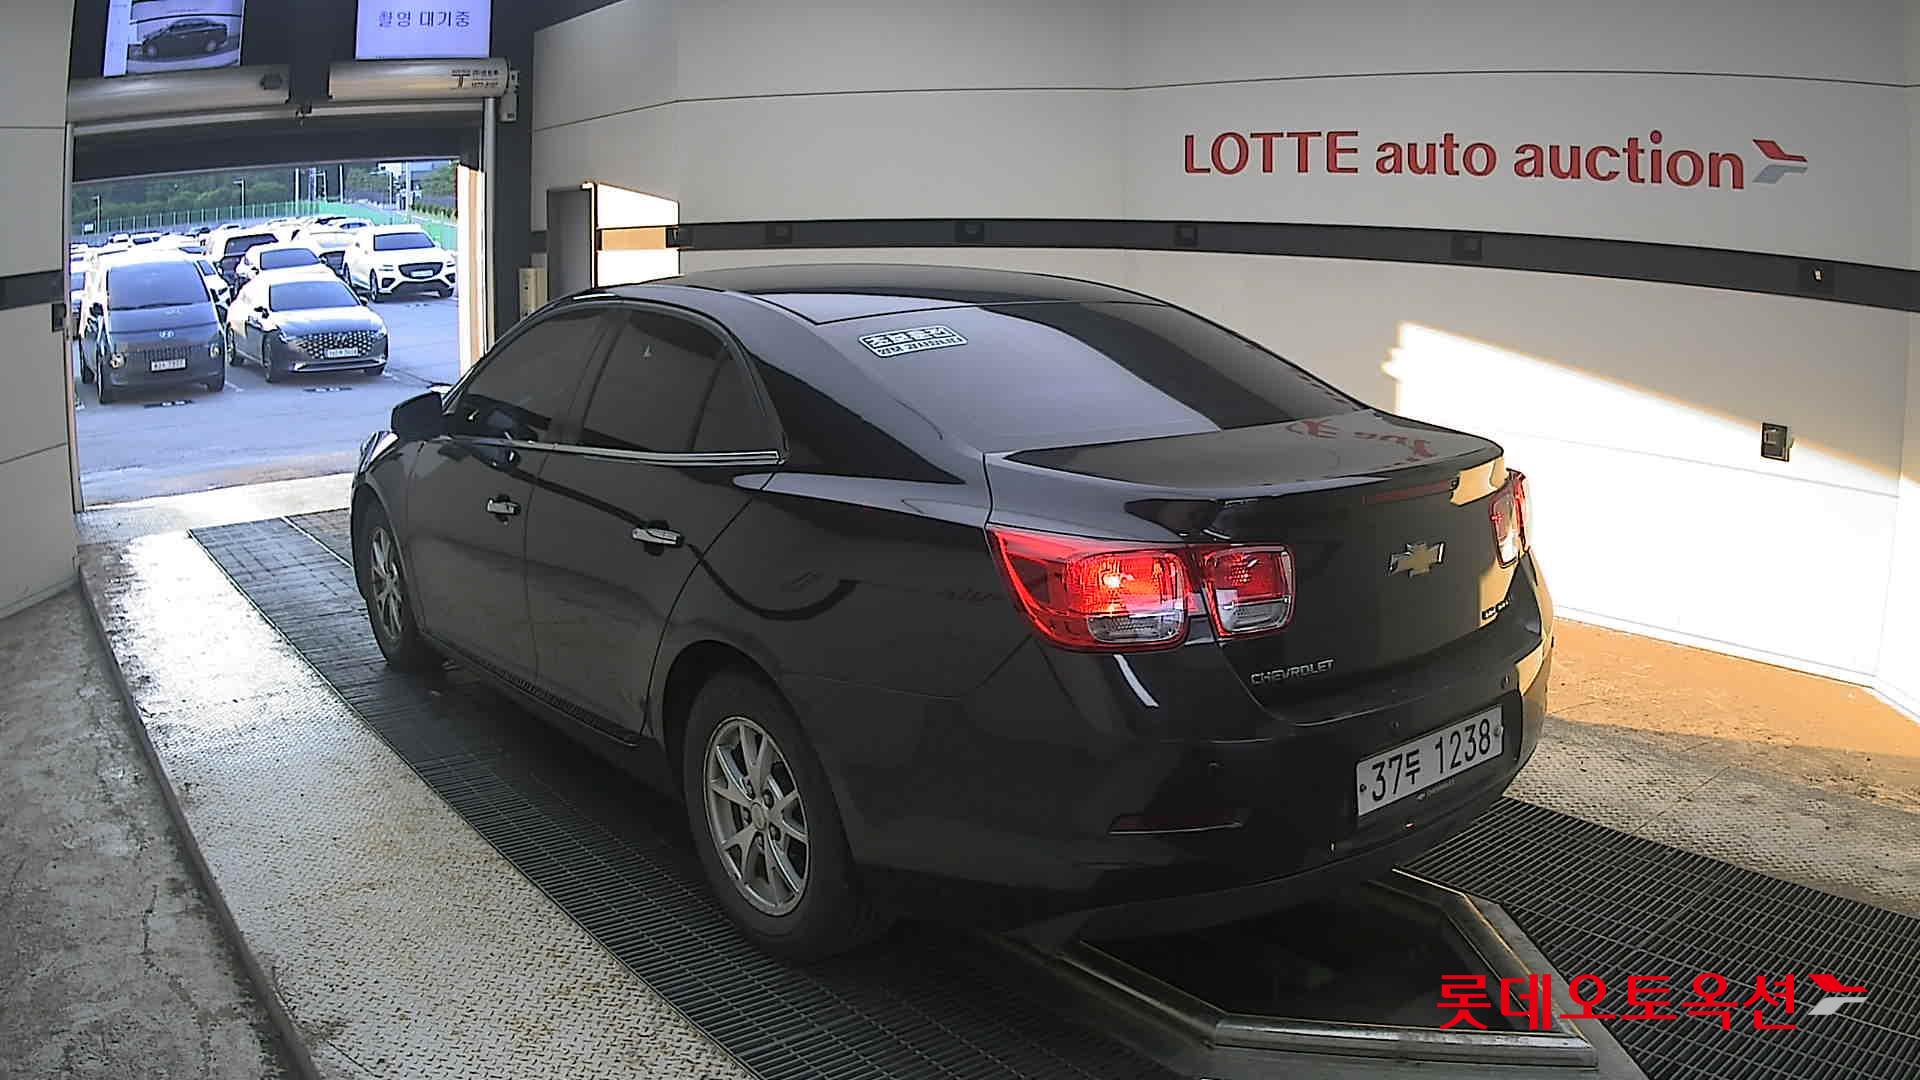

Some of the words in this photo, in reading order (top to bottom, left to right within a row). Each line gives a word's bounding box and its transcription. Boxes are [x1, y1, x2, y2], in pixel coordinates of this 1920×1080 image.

[419, 10, 470, 28] 대기중
[1184, 130, 1360, 175] LOTTE
[1375, 132, 1497, 178] auto
[1513, 130, 1745, 189] auction
[1250, 658, 1335, 685] CHEVROLET
[1371, 749, 1421, 803] 37두
[1435, 718, 1492, 774] 1238
